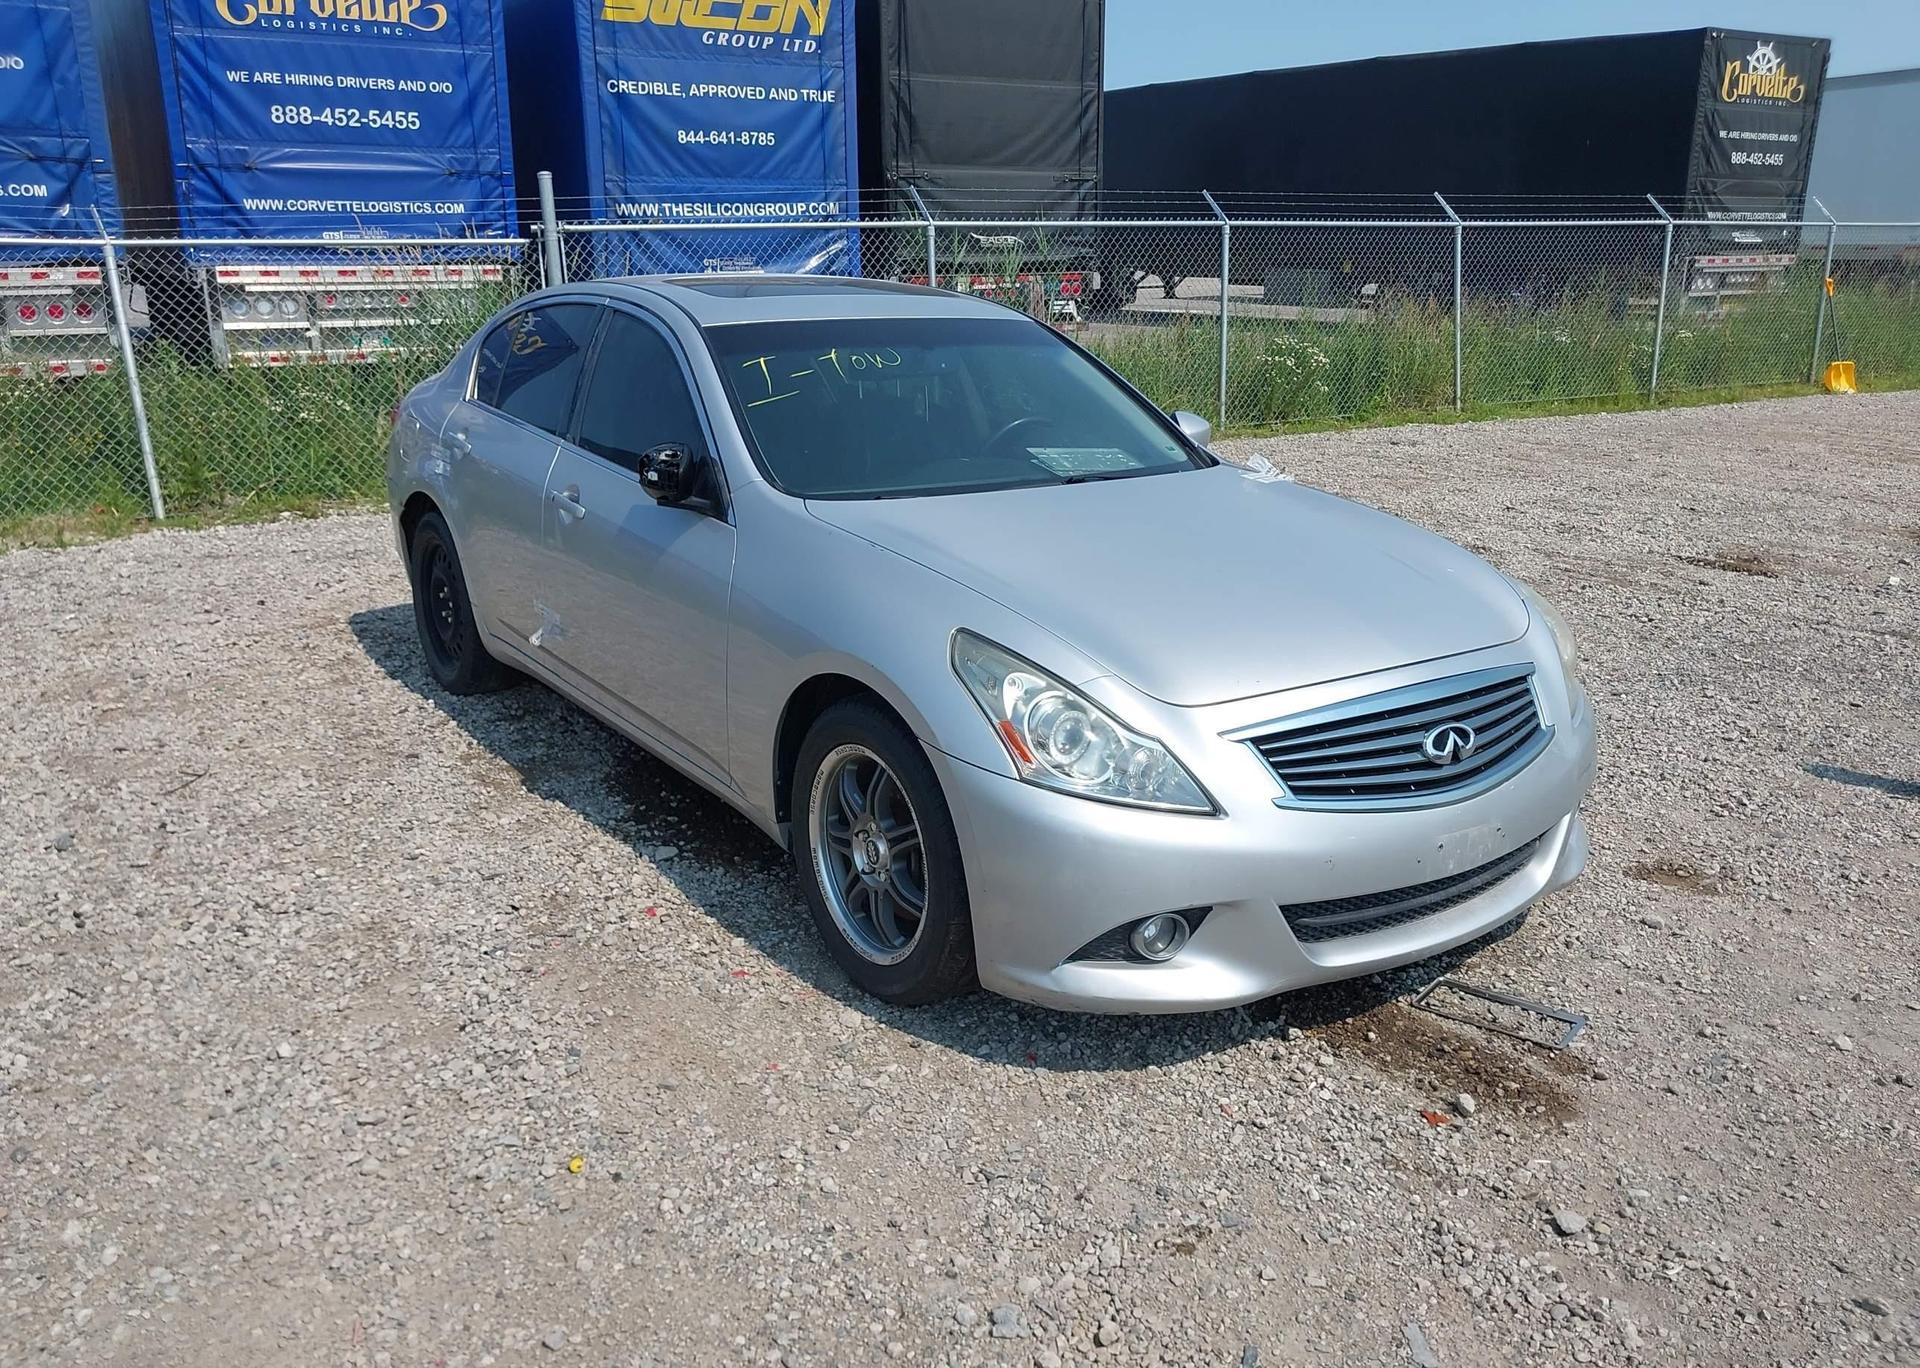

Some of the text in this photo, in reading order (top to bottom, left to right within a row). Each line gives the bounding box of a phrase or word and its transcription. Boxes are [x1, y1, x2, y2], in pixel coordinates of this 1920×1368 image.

[261, 18, 412, 37] LOGISTICS INC.
[702, 30, 821, 53] GROUP LTD.
[226, 70, 453, 93] WE ARE HIRING DRIVERS AND O/O
[1721, 60, 1805, 103] Corvette
[606, 79, 836, 103] CREDIBLE, APPROVED AND TRUE
[1736, 97, 1773, 106] LOGISTICS
[270, 105, 421, 130] 888-452-5455
[677, 130, 776, 146] 844-641-8785
[1719, 130, 1728, 139] WE
[1728, 131, 1741, 139] ARE
[1741, 131, 1757, 140] HIRING
[1757, 132, 1779, 141] DRIVERS
[1779, 133, 1789, 142] AND
[1730, 151, 1784, 166] 888-452-5455
[243, 198, 465, 215] WWW.CORVETTELOGISTICS.COM
[615, 202, 840, 218] WWW.THESILICONGROUP.COM
